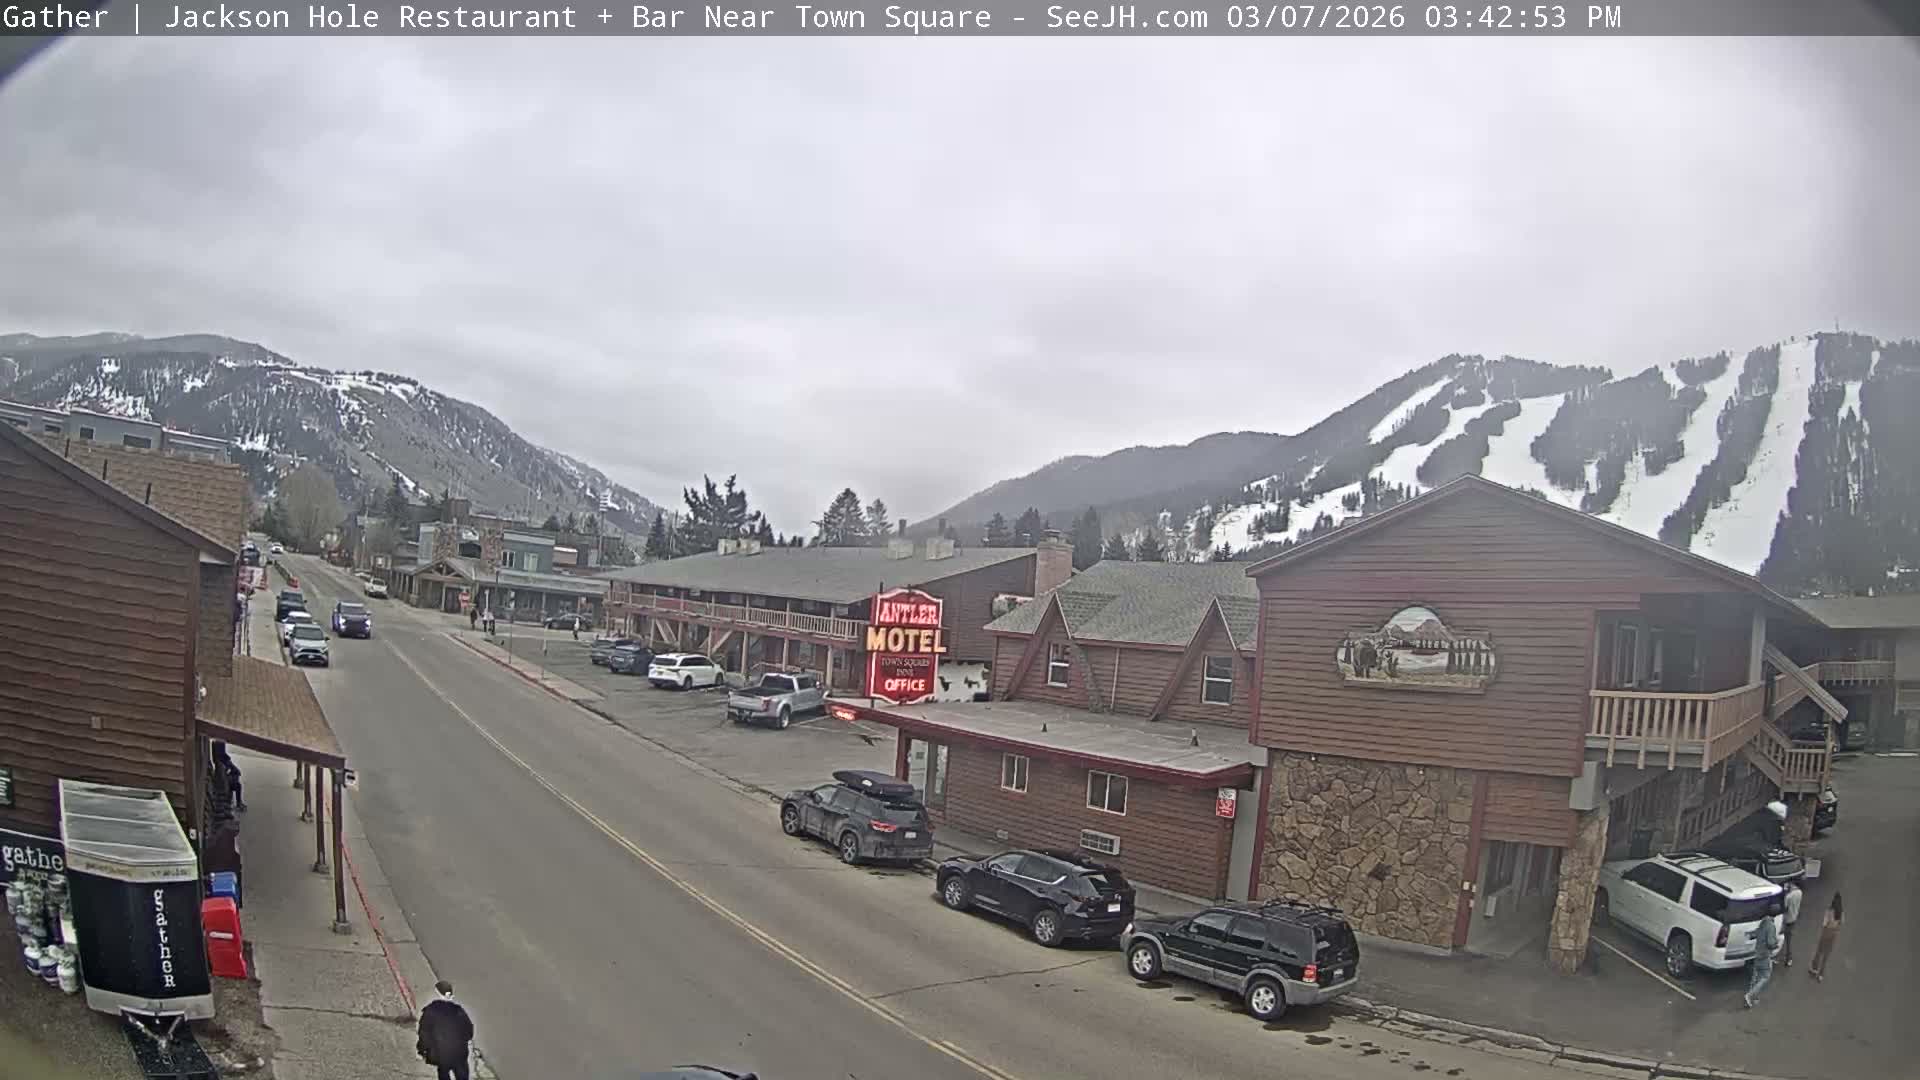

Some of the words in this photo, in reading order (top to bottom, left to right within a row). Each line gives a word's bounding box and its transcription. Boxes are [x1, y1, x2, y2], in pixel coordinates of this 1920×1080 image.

[880, 603, 938, 624] ANTLER
[866, 626, 947, 653] MOTEL
[884, 678, 926, 692] OFFICE
[2, 845, 64, 872] gathe
